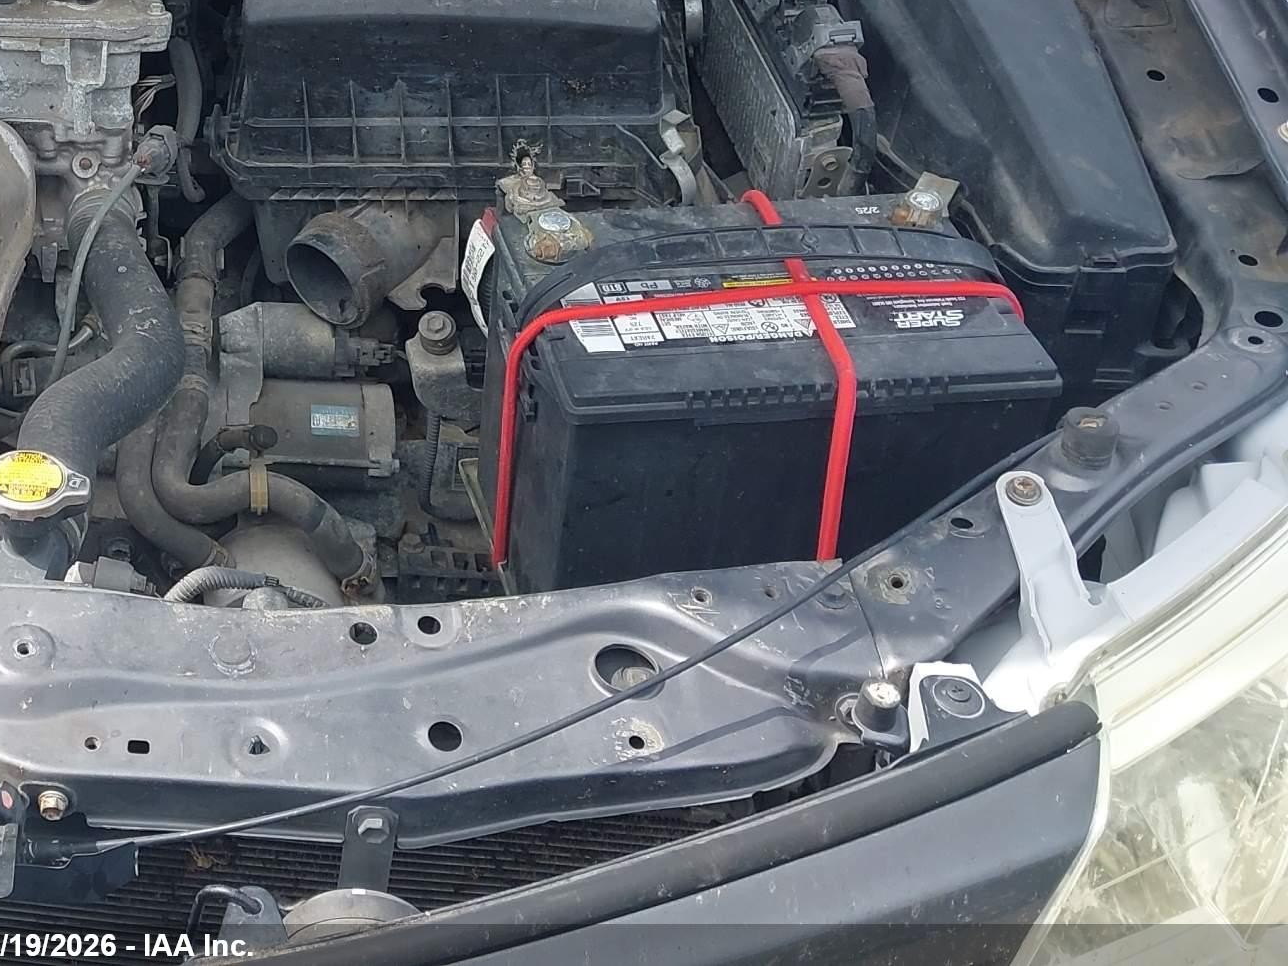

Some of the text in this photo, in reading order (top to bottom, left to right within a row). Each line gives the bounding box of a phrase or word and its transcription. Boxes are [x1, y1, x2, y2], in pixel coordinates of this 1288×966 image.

[640, 281, 658, 290] Pb
[893, 309, 964, 321] START
[896, 318, 961, 329] SUPER
[710, 331, 803, 342] DANGER/POISON
